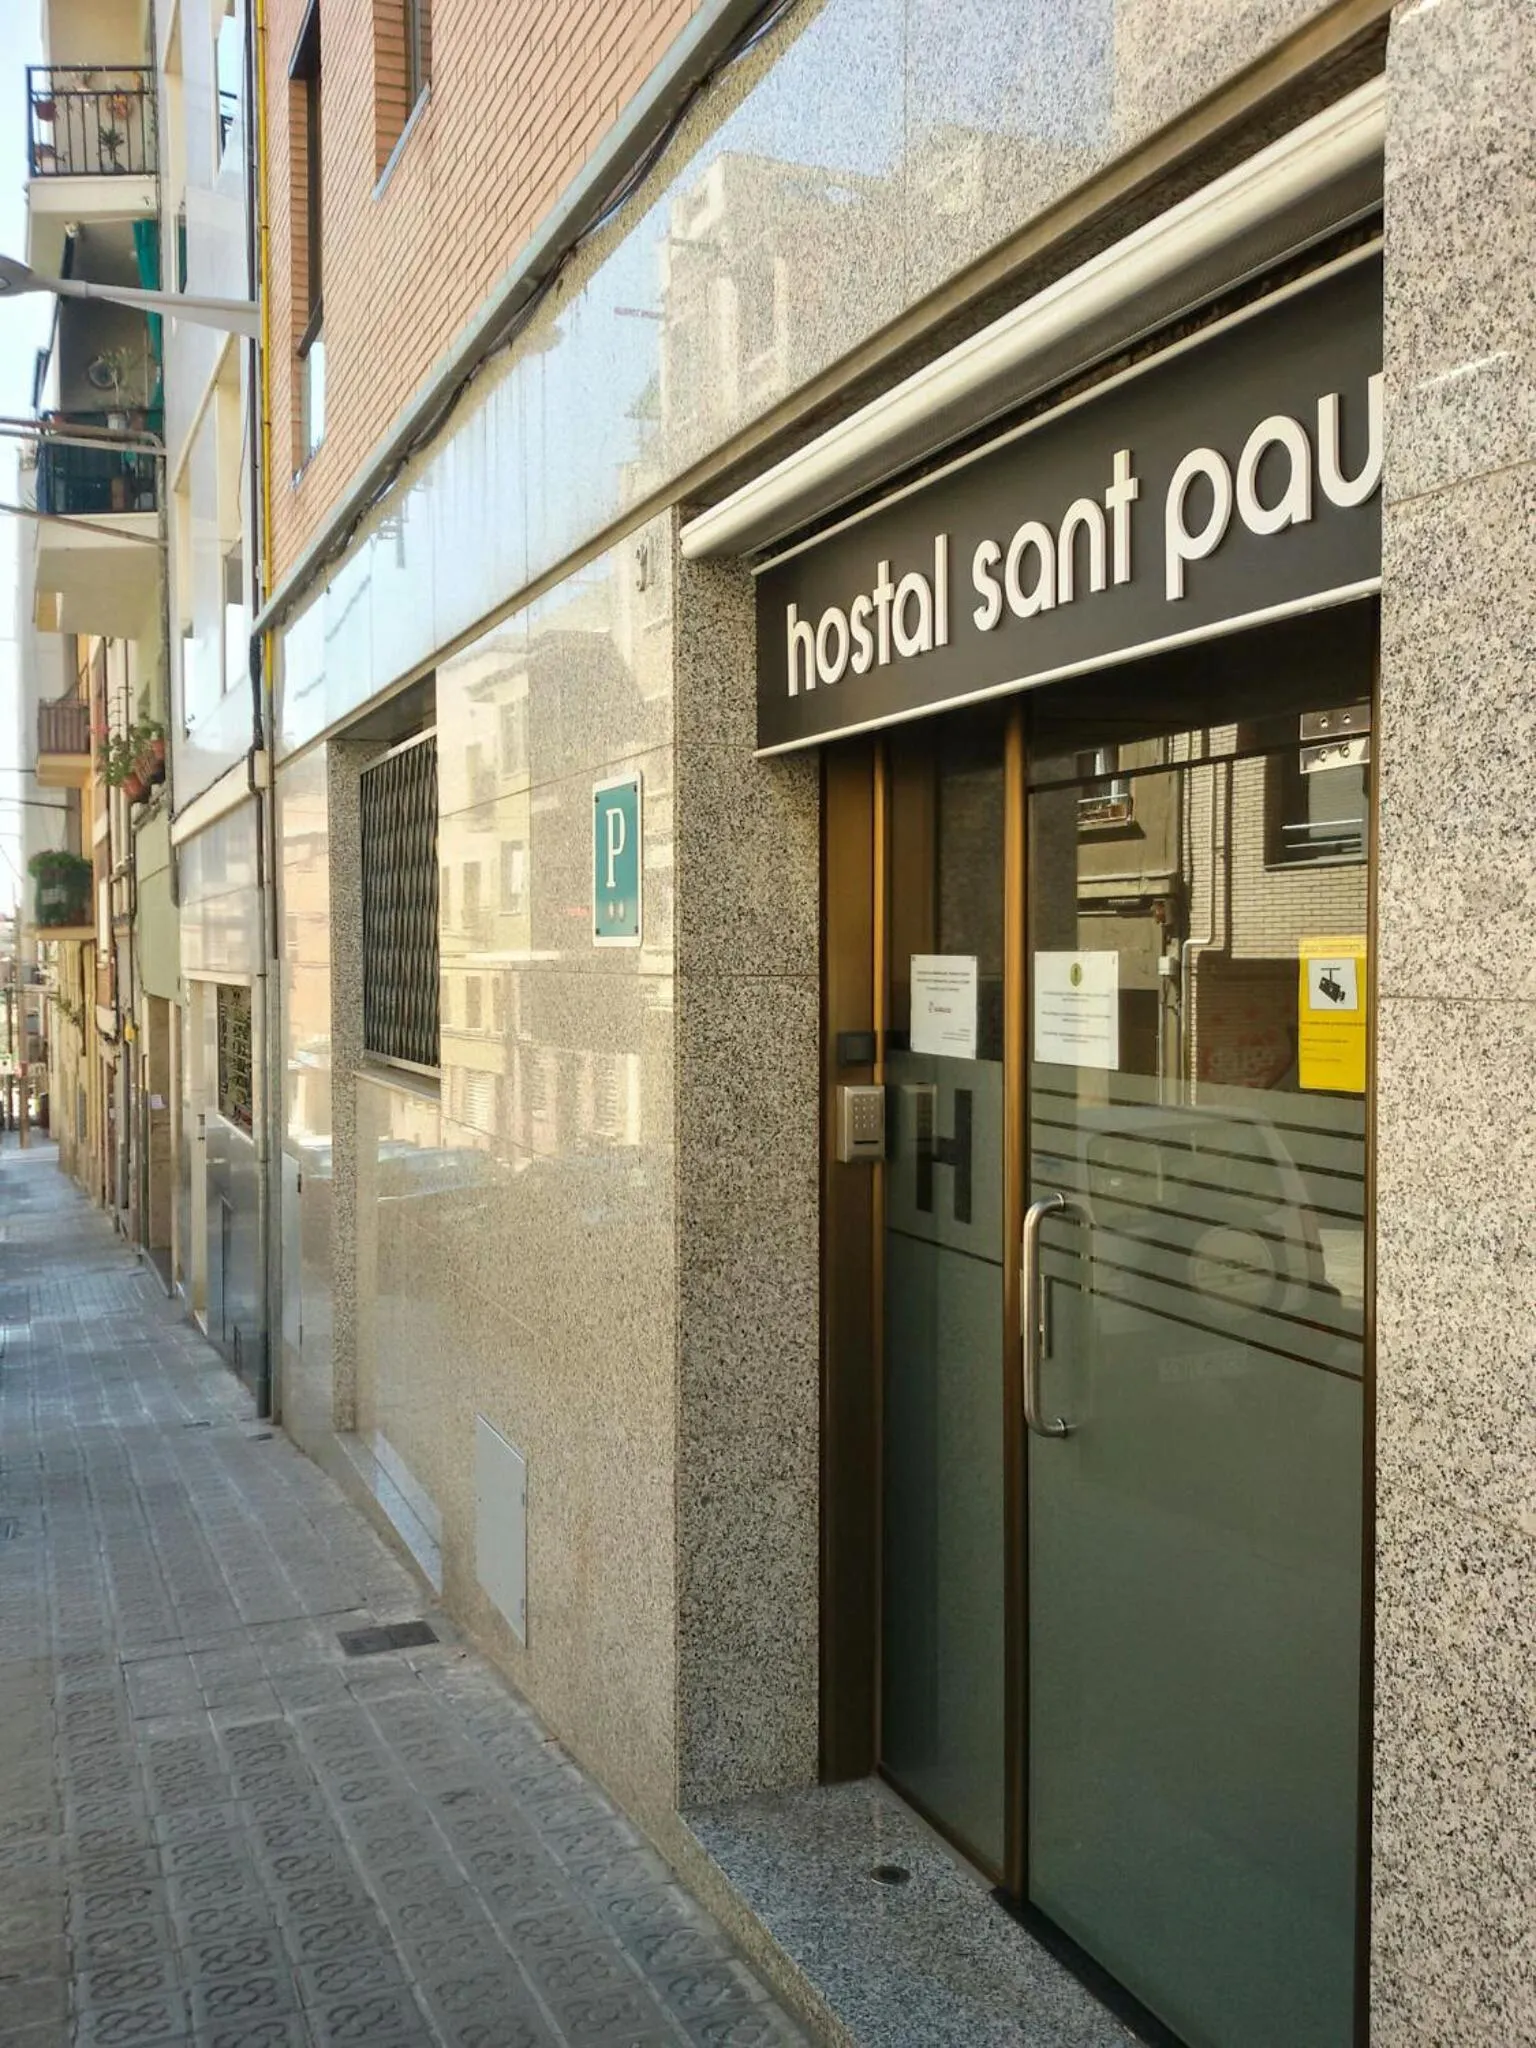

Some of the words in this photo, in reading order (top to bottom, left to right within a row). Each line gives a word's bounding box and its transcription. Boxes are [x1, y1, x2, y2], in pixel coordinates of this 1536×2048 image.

[787, 533, 949, 697] hostal
[972, 449, 1139, 632] sant
[1165, 371, 1384, 601] pau
[605, 807, 626, 888] P
[915, 1087, 973, 1225] H
